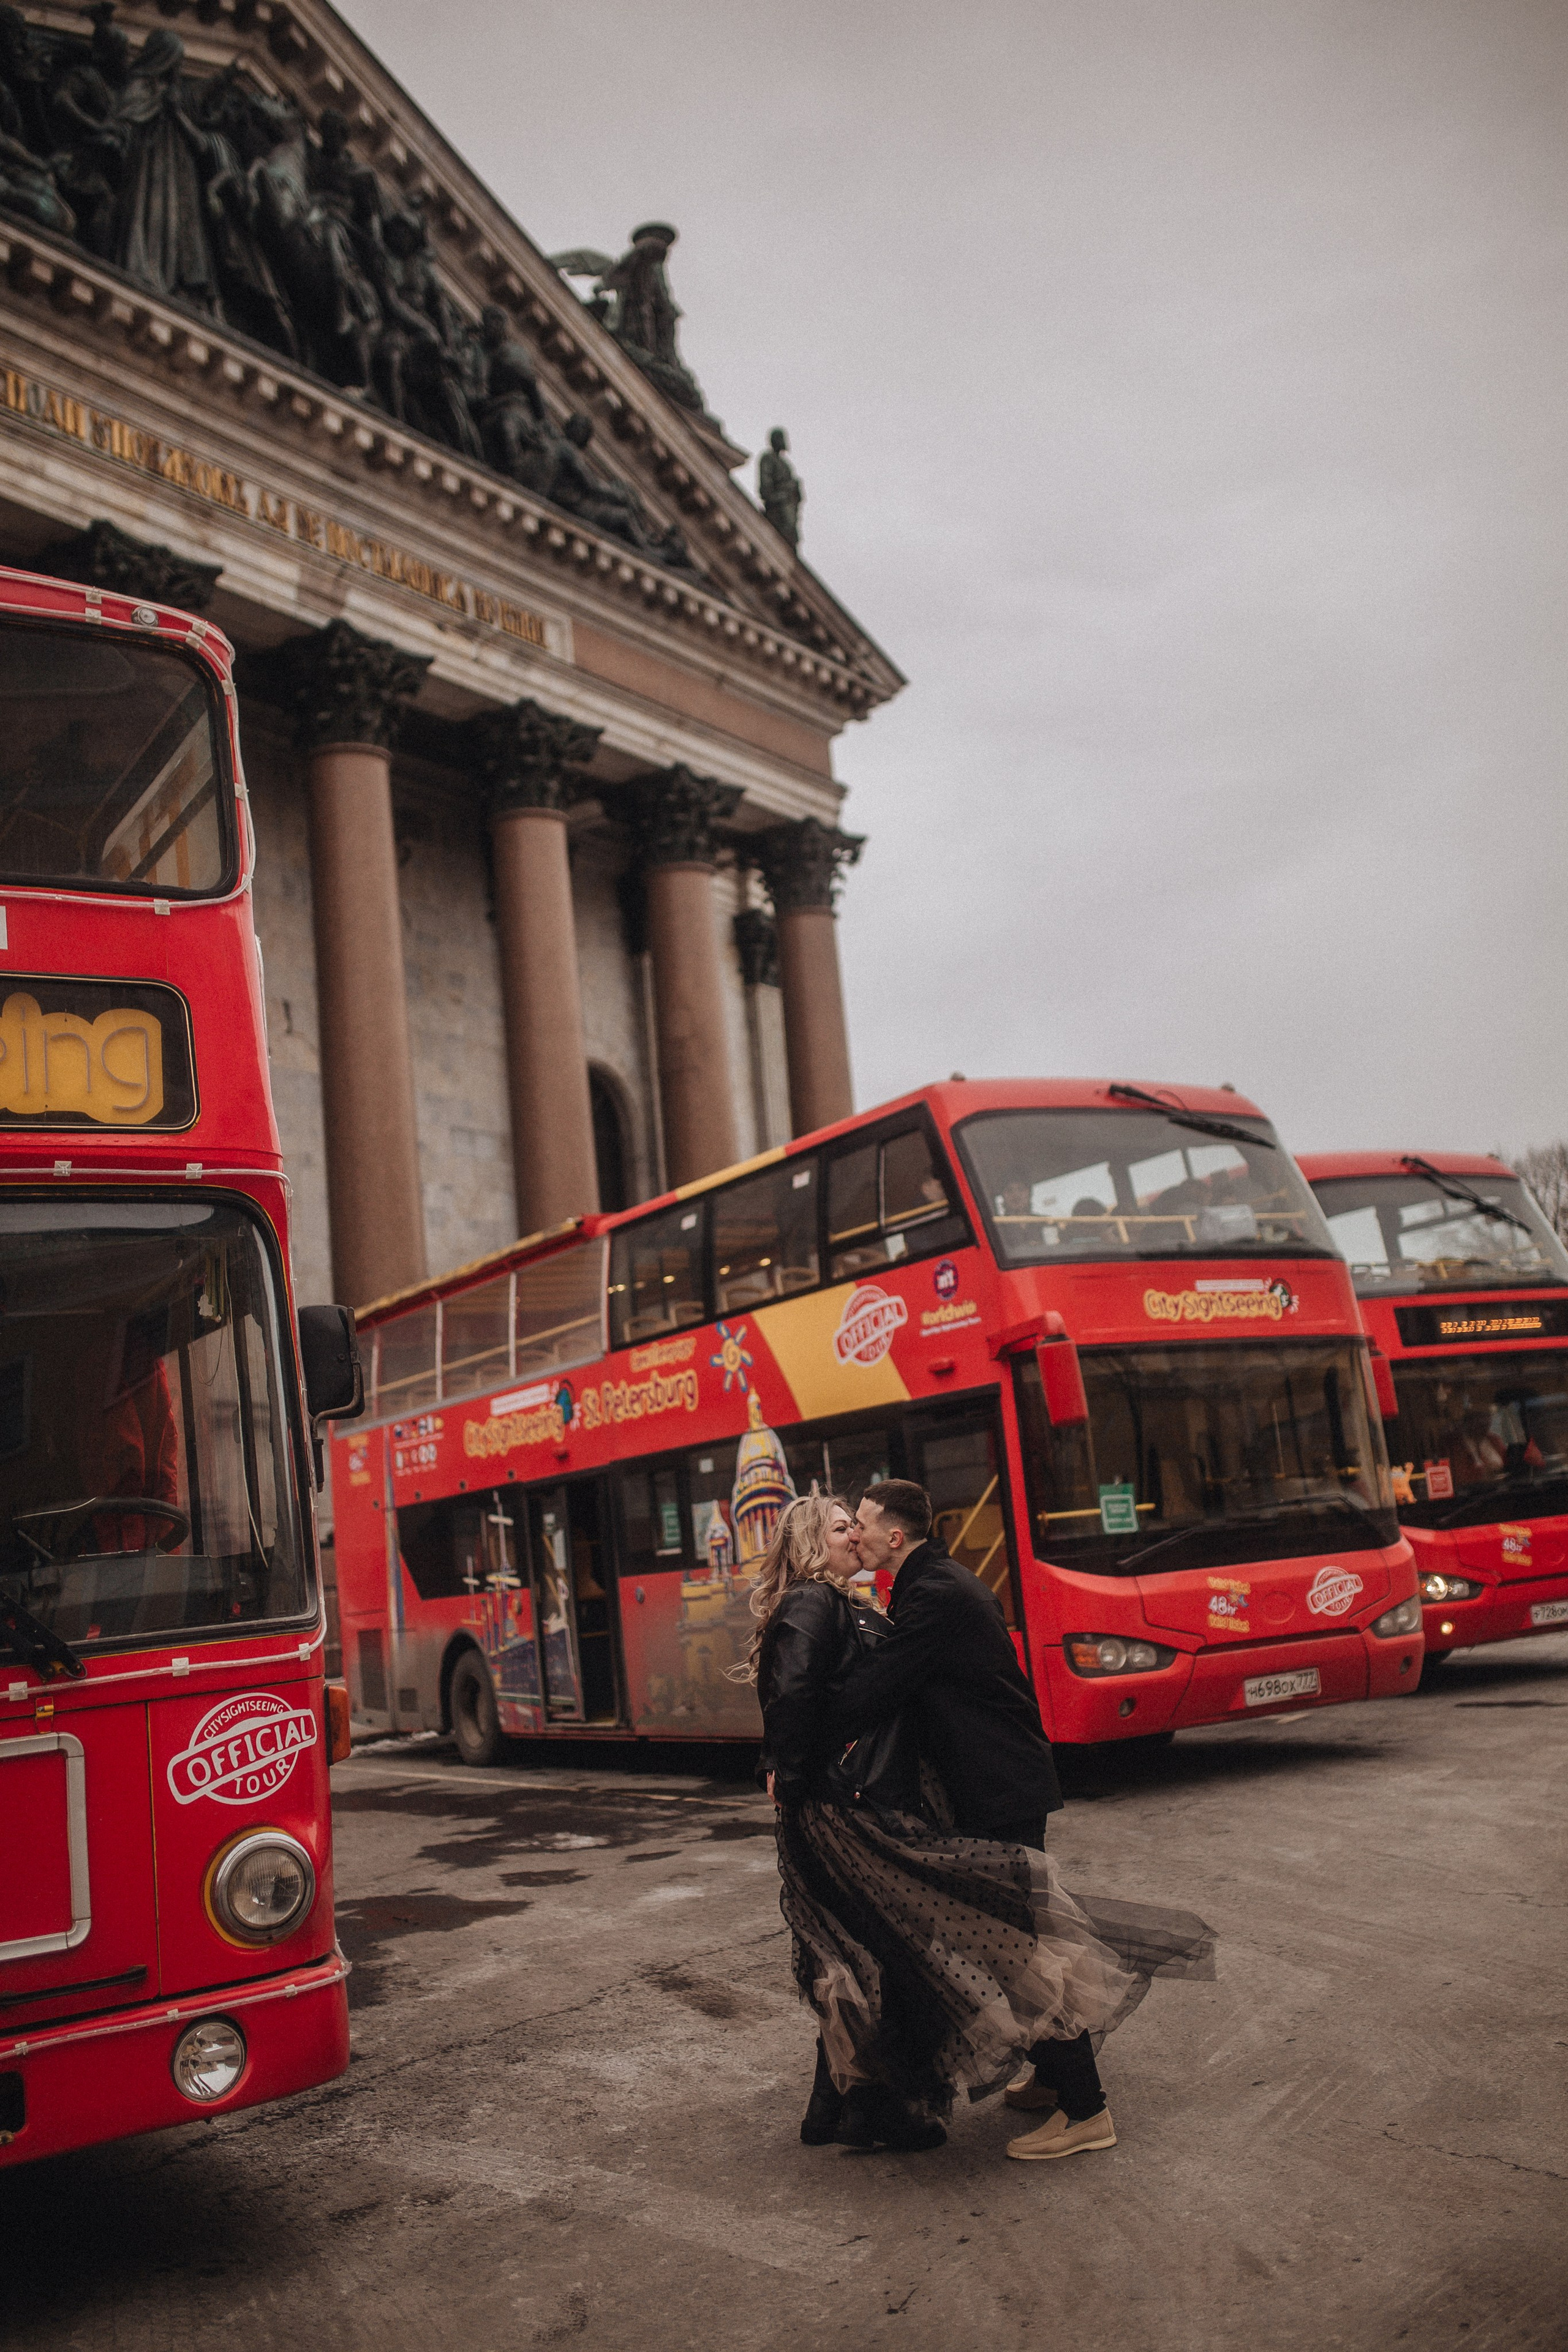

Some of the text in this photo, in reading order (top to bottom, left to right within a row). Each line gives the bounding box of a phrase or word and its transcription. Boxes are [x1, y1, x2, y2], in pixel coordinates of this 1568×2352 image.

[0, 1003, 152, 1112] ing
[840, 1302, 904, 1353] OFFICIAL
[1313, 1578, 1360, 1607] OFFICIAL
[1330, 1594, 1352, 1611] TOUR
[203, 1700, 284, 1740] CITYSIGHTSEEING
[187, 1717, 312, 1787] OFFICIAL
[234, 1758, 290, 1795] TOUR
